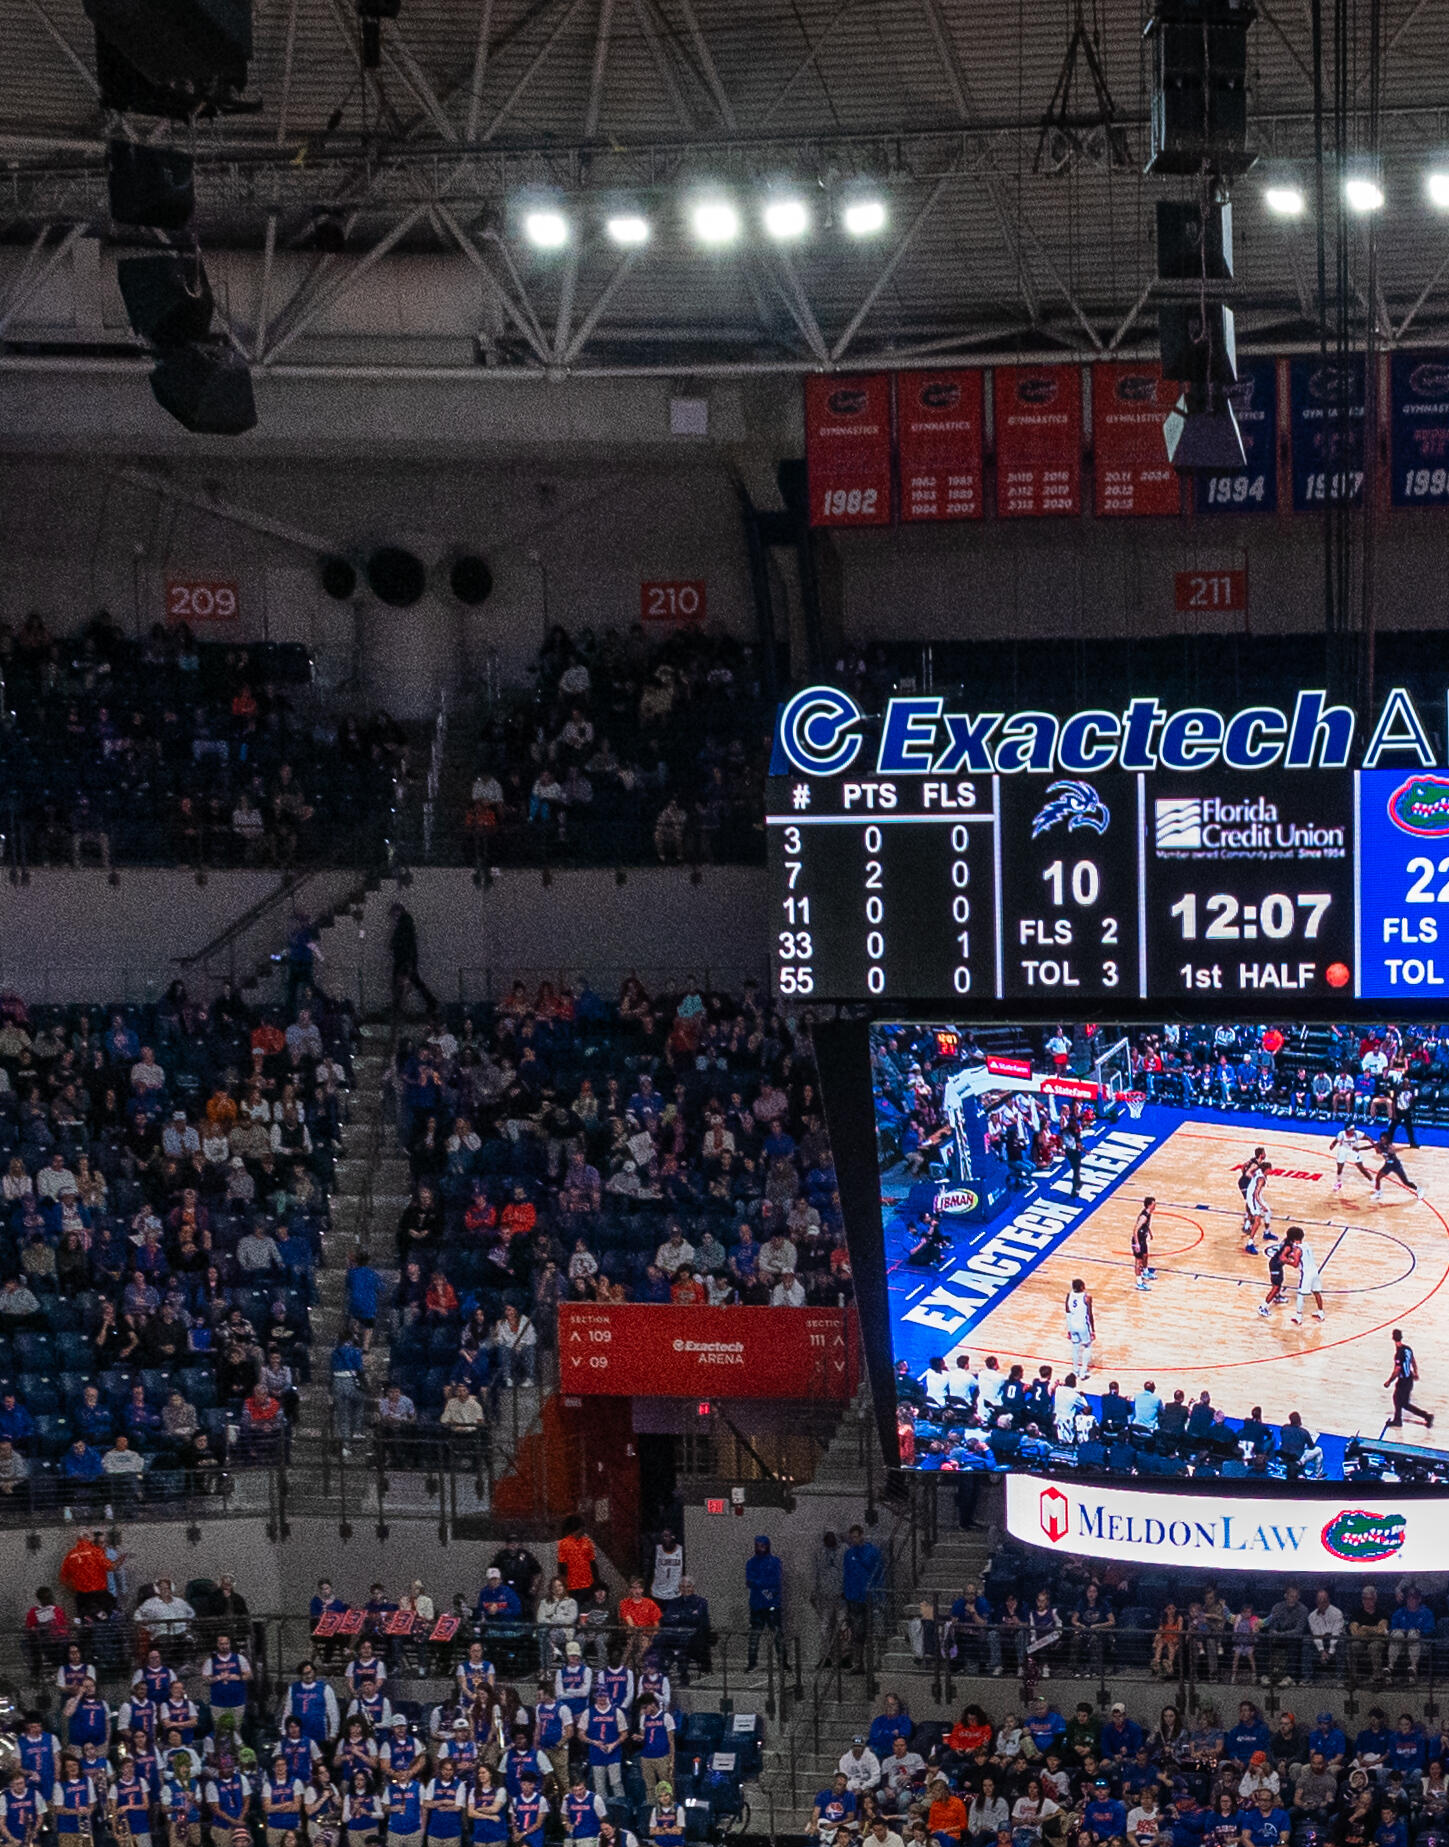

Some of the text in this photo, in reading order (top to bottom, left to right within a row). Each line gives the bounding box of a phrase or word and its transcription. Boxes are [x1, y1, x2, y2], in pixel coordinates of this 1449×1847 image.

[823, 490, 877, 514] 1982
[1208, 477, 1264, 503] 1994
[171, 586, 236, 616] 209
[648, 587, 700, 616] 210
[1189, 578, 1232, 605] 211
[876, 690, 1355, 773] Exactech
[793, 782, 975, 809] # PTS FLS
[1203, 796, 1277, 822] Florida
[784, 825, 968, 855] 3 0 0
[1202, 823, 1344, 848] Credit Union
[785, 861, 968, 889] 7 2 0
[1043, 861, 1098, 905] 10
[783, 896, 969, 924] 11 0 0
[1172, 894, 1331, 939] 12:07
[1020, 918, 1117, 944] FLS 2
[1384, 917, 1437, 942] FLS
[779, 932, 971, 959] 33 0 1
[780, 966, 970, 993] 55 0 0
[1022, 961, 1118, 986] TOL 3
[1181, 963, 1315, 988] 1st HALF
[1384, 960, 1444, 984] TOL
[901, 1197, 1083, 1335] EXACTECH
